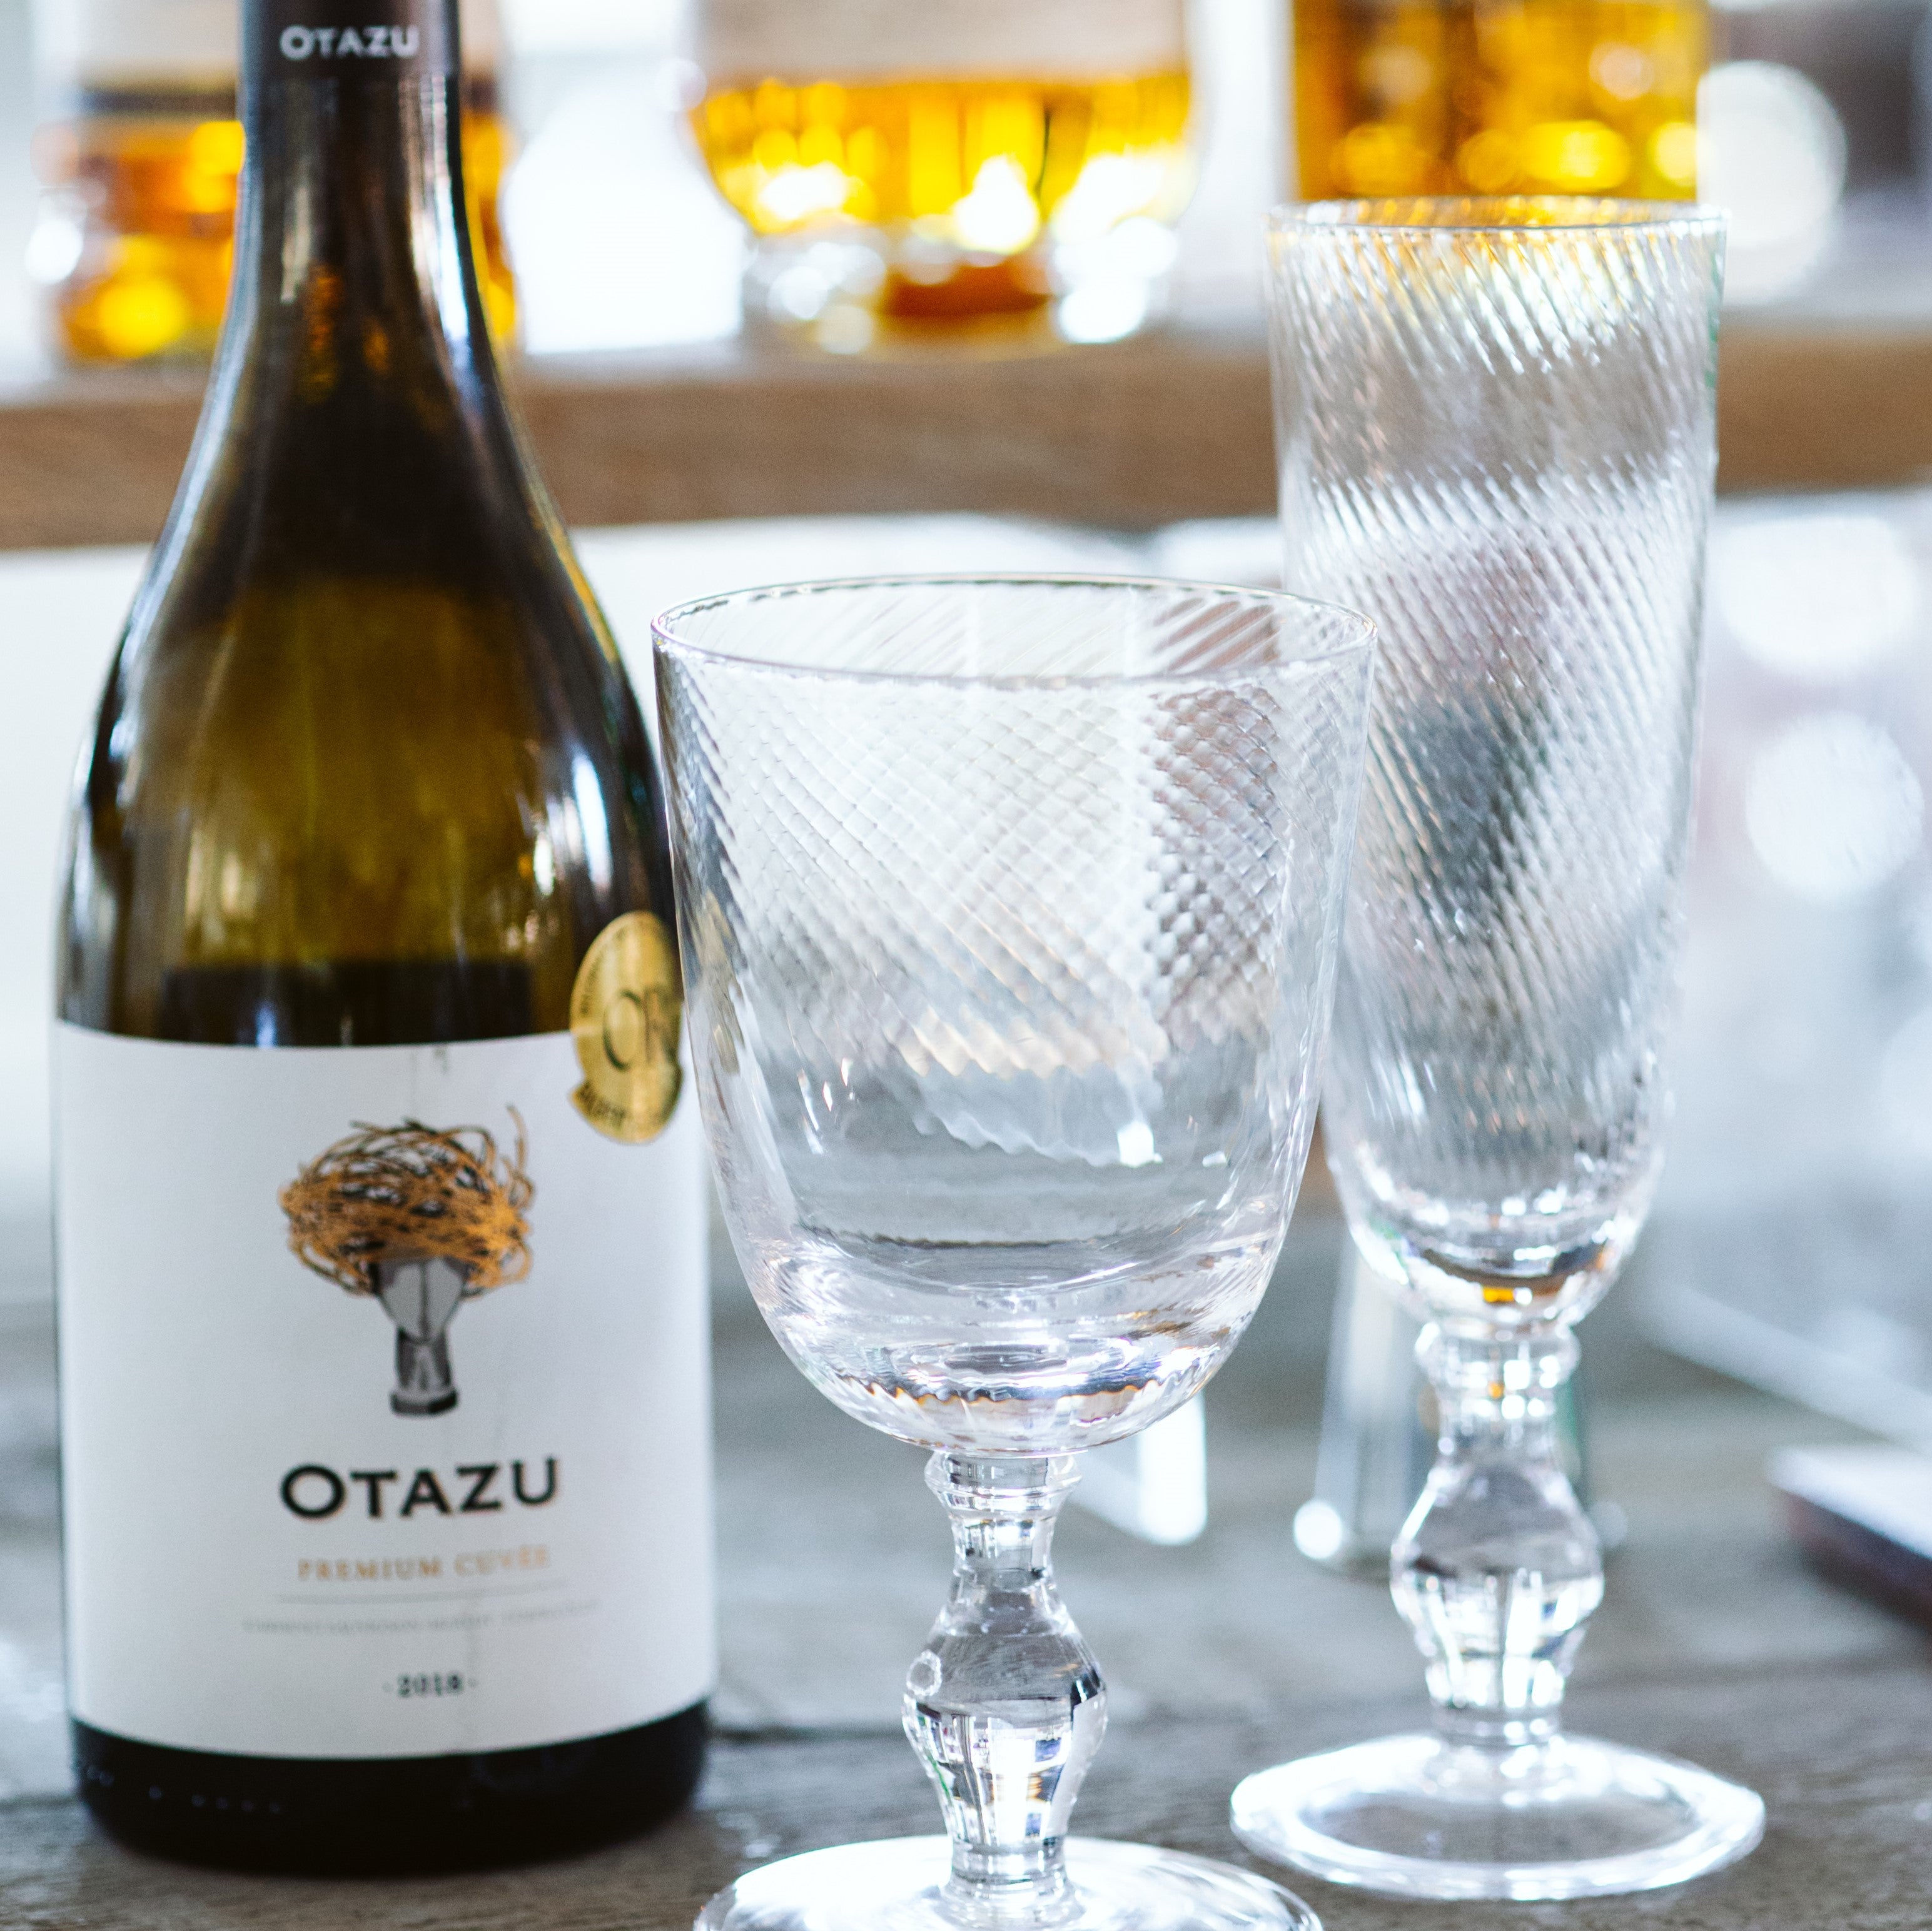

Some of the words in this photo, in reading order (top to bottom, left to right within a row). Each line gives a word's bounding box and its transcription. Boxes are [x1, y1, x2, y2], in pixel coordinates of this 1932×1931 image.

[280, 24, 419, 60] OTAZU
[280, 1456, 559, 1520] OTAZU
[297, 1557, 442, 1580] PREMIUM
